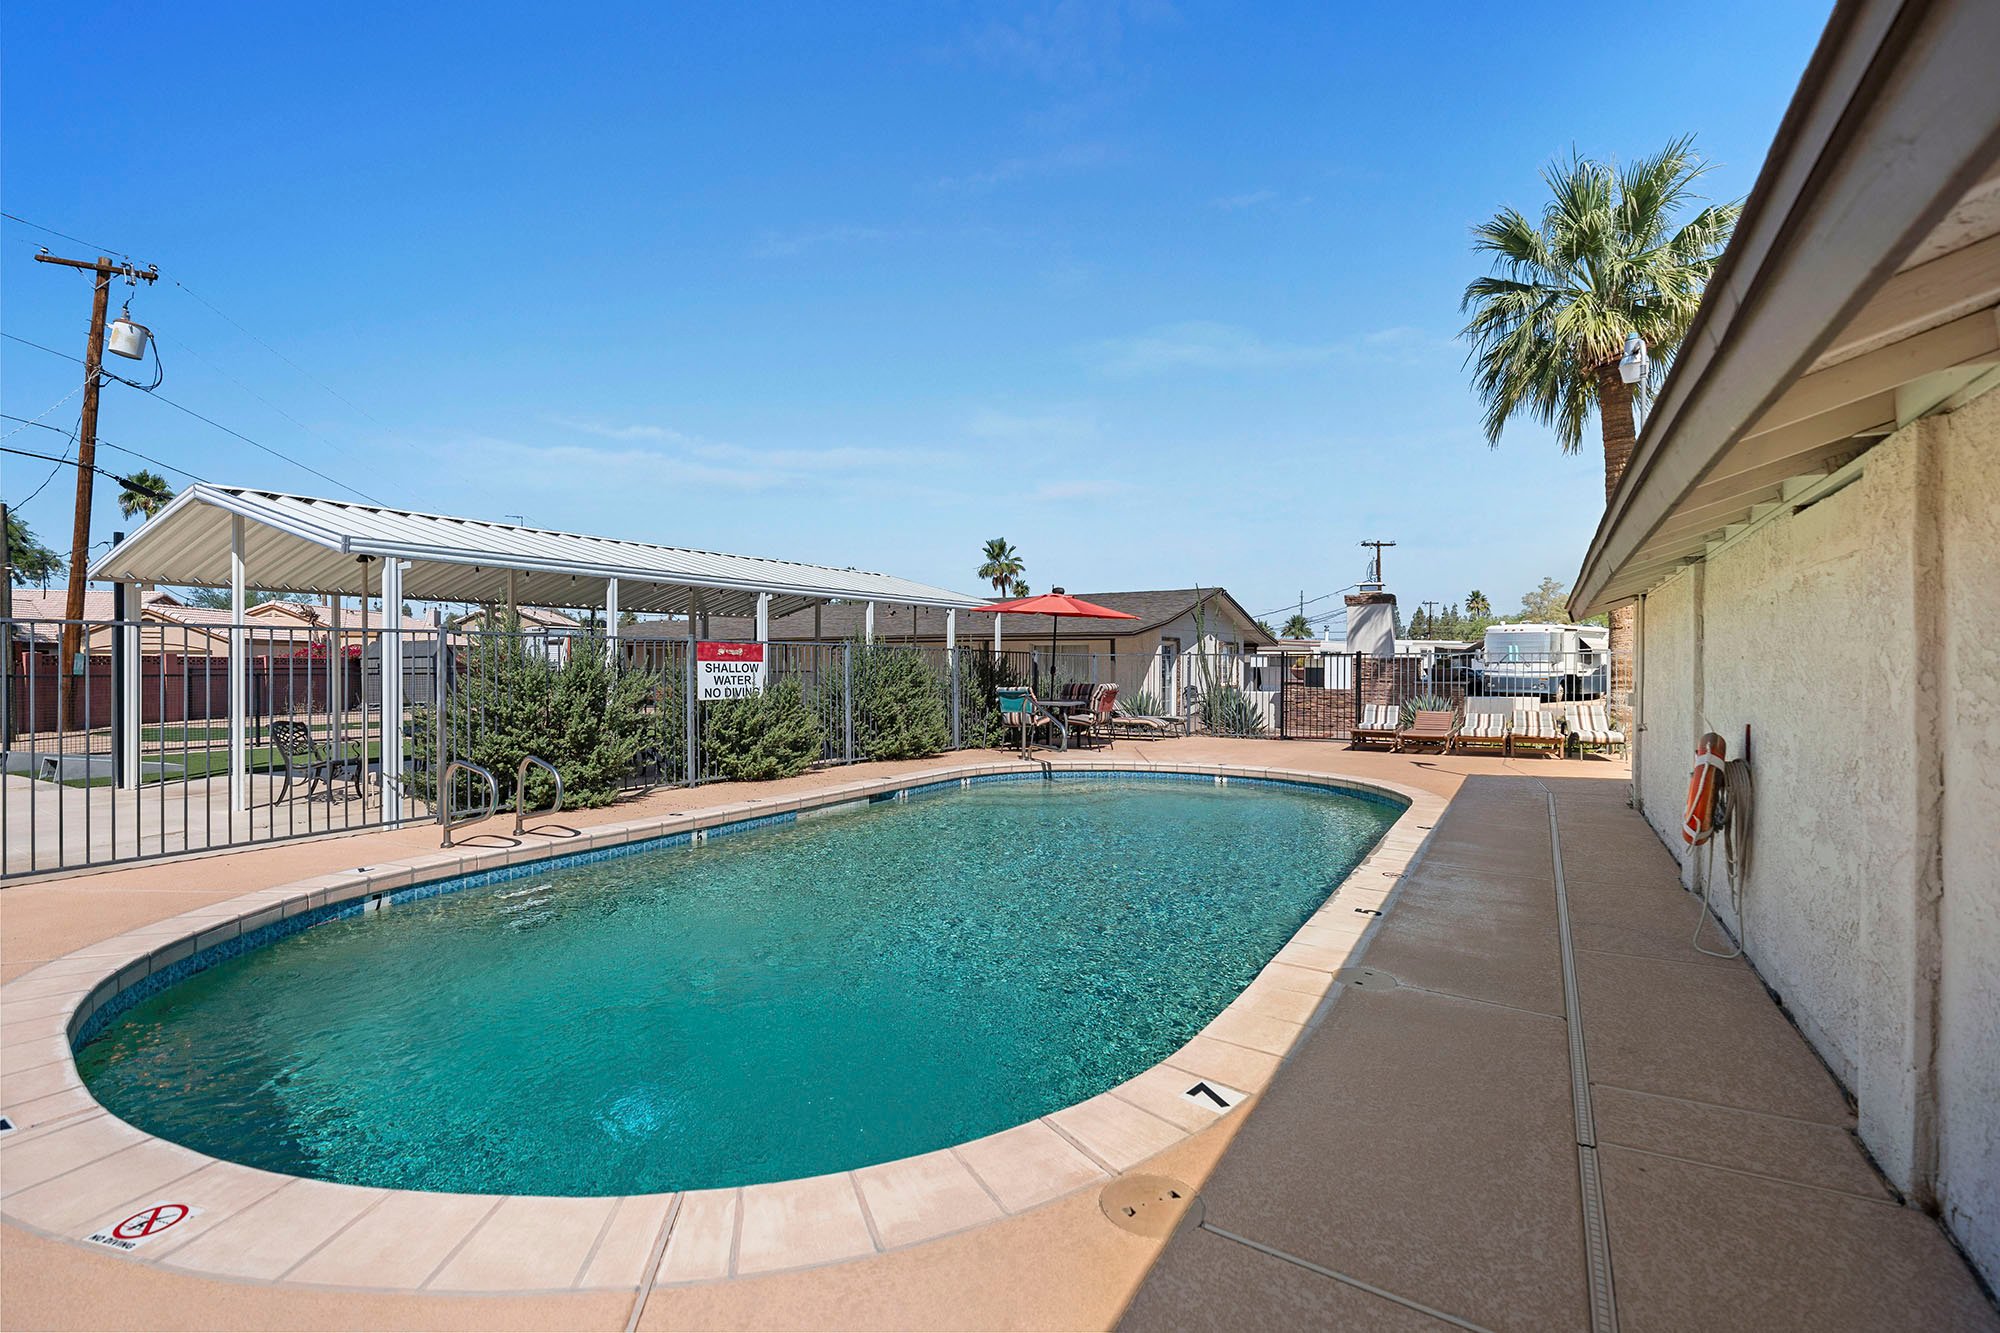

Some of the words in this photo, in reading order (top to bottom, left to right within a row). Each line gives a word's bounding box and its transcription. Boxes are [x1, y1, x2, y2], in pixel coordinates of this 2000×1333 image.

[705, 663, 759, 673] SHALLOW
[714, 675, 751, 685] WATER
[705, 688, 721, 698] NO
[1186, 1081, 1231, 1108] 7
[89, 1234, 106, 1242] NO
[102, 1237, 136, 1250] DIVING
